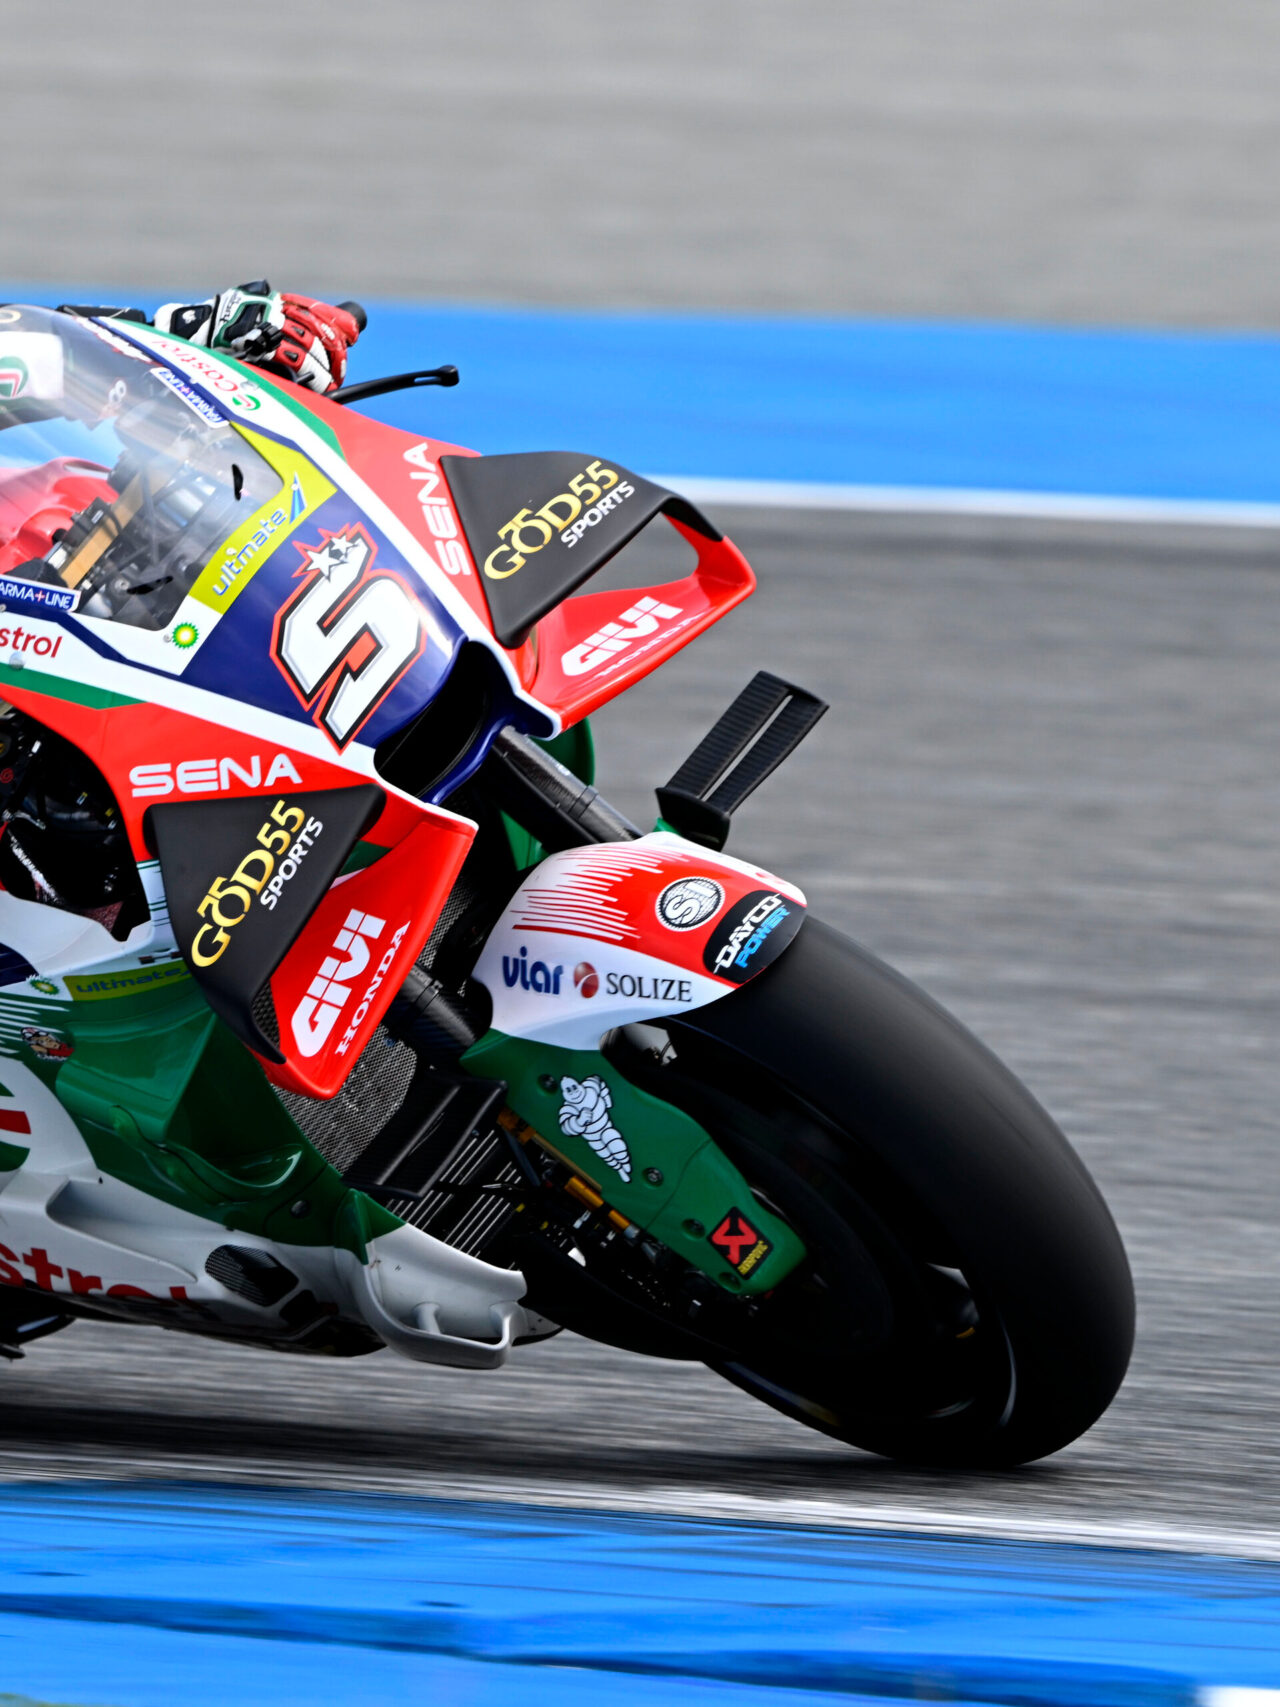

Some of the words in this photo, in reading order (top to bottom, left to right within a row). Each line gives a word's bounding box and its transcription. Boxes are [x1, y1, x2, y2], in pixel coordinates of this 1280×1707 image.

[403, 442, 472, 576] SENA
[483, 460, 619, 580] GOD55
[560, 481, 635, 548] SPORTS
[212, 507, 286, 597] ultimate
[561, 596, 684, 676] GIVI
[129, 753, 303, 798] SENA
[191, 799, 306, 967] GOD55
[260, 816, 324, 911] SPORTS
[502, 946, 563, 995] viar
[606, 972, 692, 1002] SOLIZE
[715, 895, 783, 970] DAYCO
[735, 905, 791, 968] POWER
[76, 967, 181, 994] ultimate
[290, 908, 387, 1057] GIVI
[335, 919, 411, 1056] HONDA
